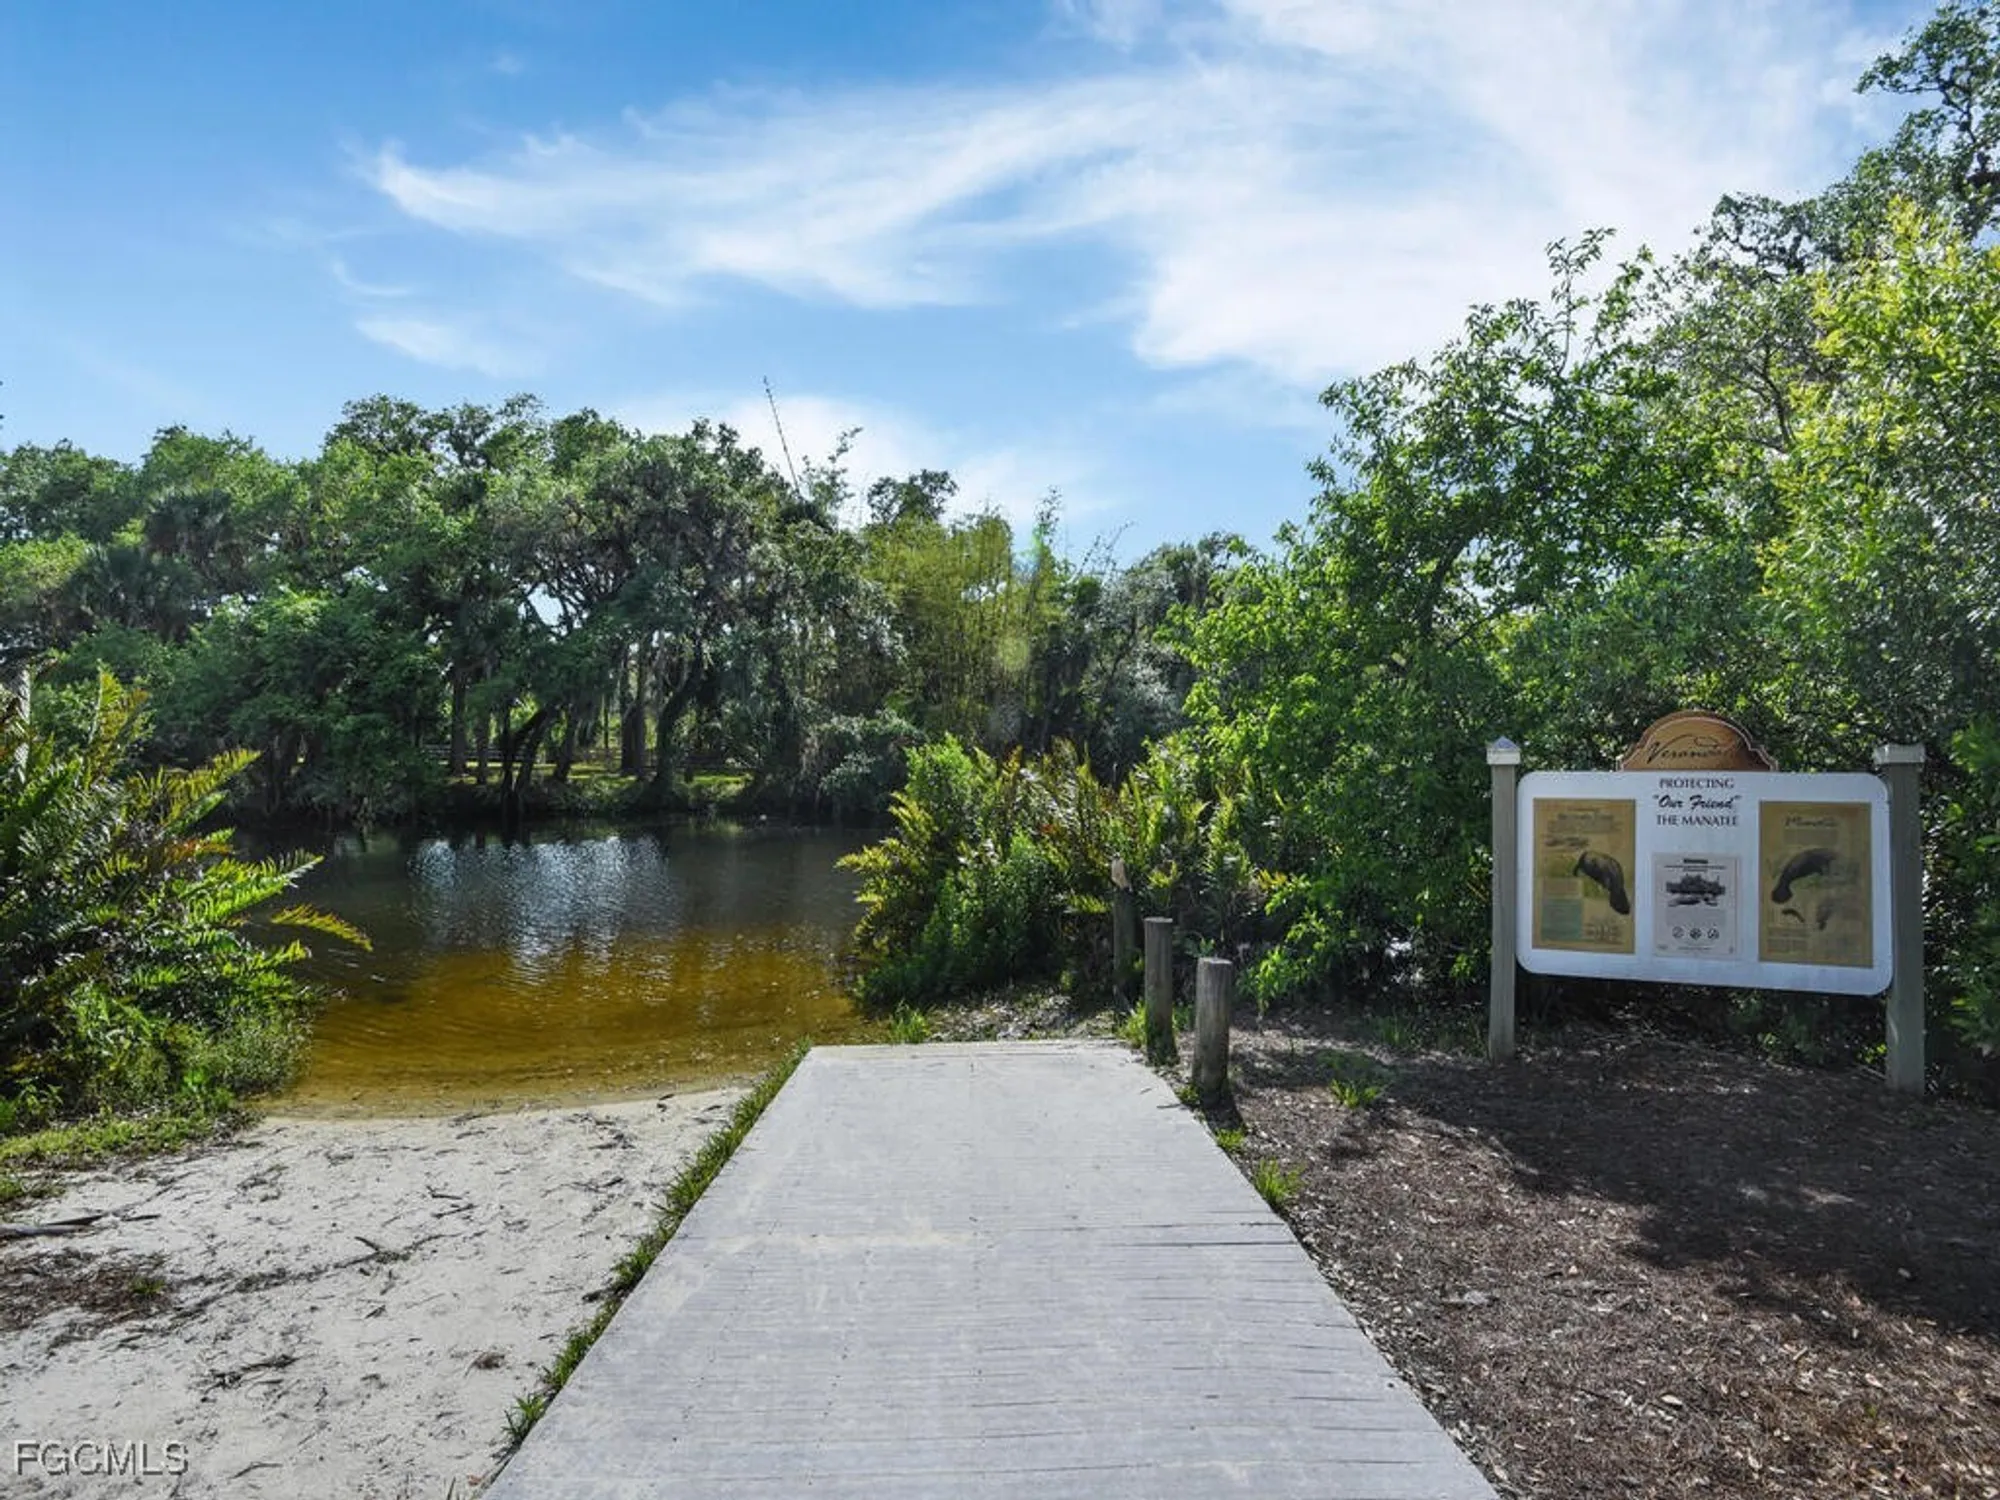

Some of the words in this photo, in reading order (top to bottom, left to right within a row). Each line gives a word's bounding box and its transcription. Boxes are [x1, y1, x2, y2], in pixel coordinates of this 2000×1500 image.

[1659, 777, 1735, 789] PROTECTING
[1653, 794, 1683, 809] "Our
[1656, 814, 1678, 826] THE
[1682, 814, 1739, 827] MANATEE
